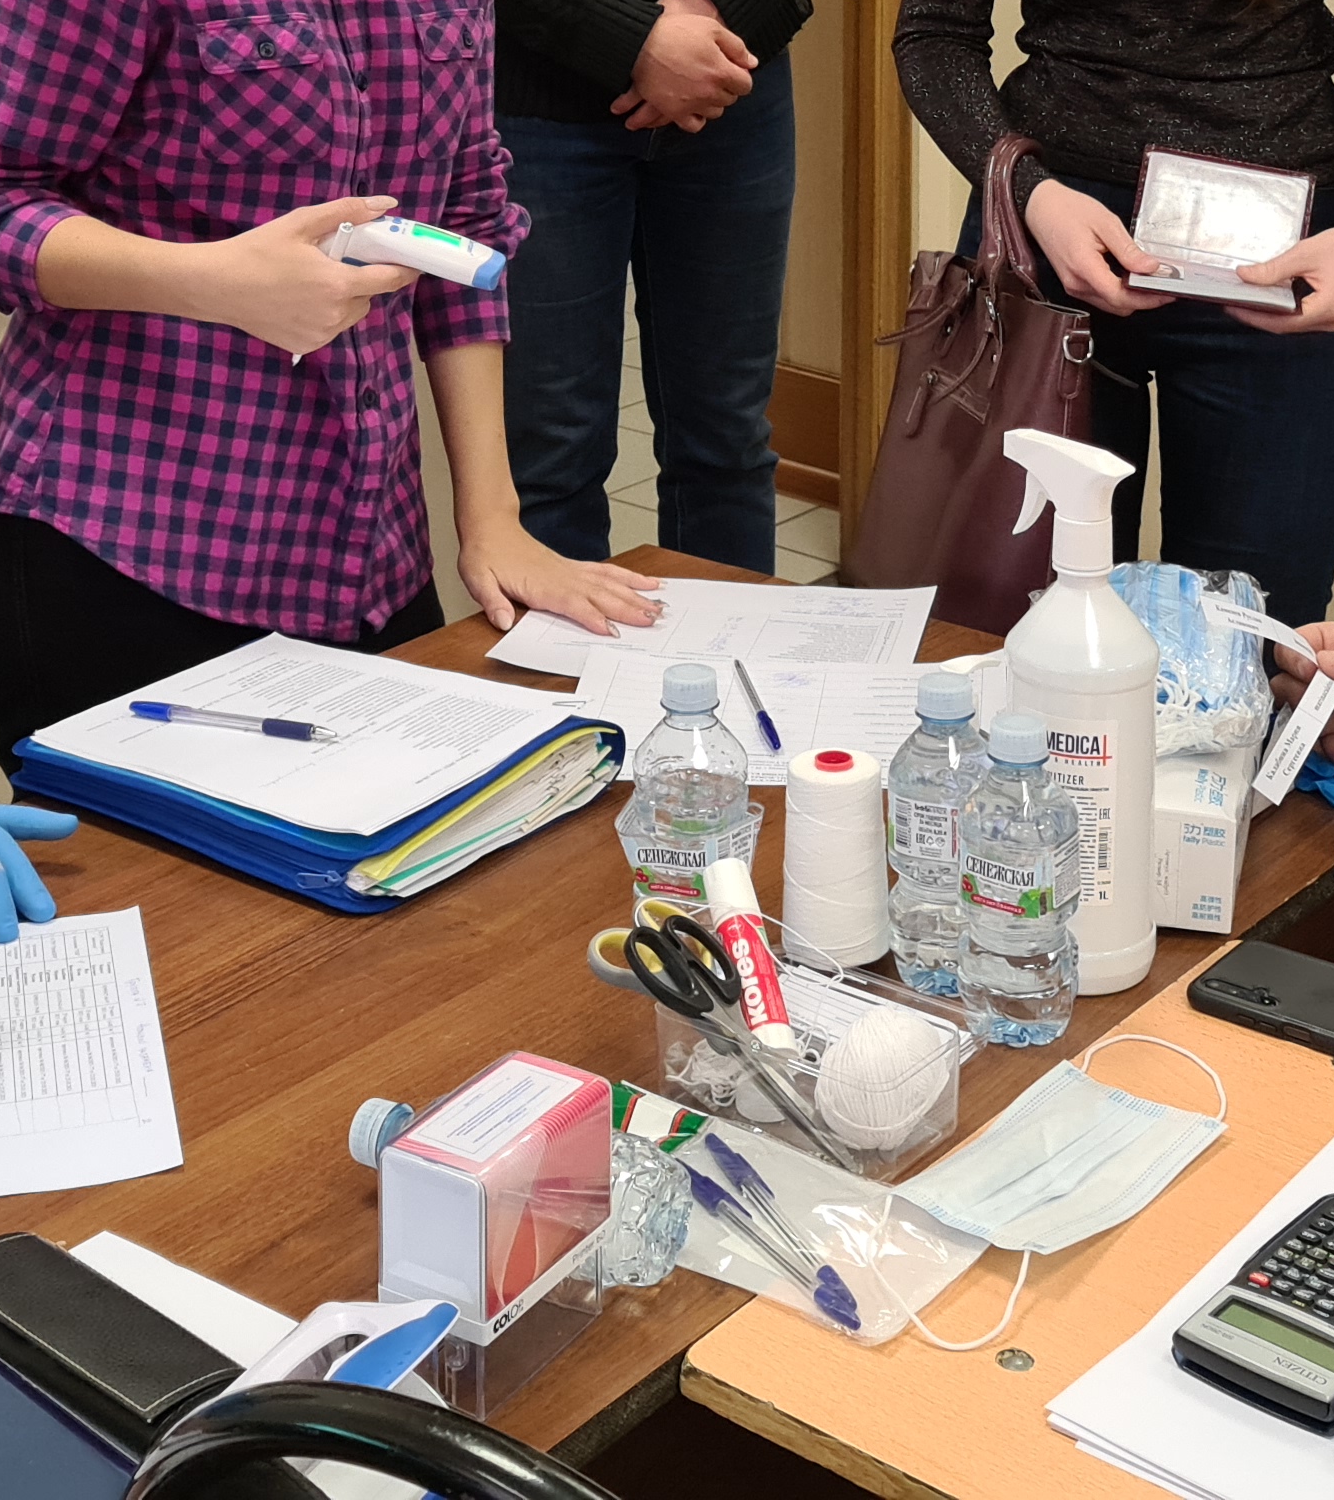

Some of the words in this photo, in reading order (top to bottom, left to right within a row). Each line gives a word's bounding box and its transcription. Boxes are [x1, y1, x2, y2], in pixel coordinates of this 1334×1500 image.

[1046, 730, 1101, 756] MEDICA
[1201, 837, 1226, 847] Plastic
[637, 848, 707, 868] СЕНЕЖСКАЯ
[966, 854, 1035, 887] СЕНЕЖСКАЯ
[1098, 890, 1109, 900] 1L
[492, 1298, 525, 1334] COLOP
[1272, 1355, 1328, 1387] CITIZEN
